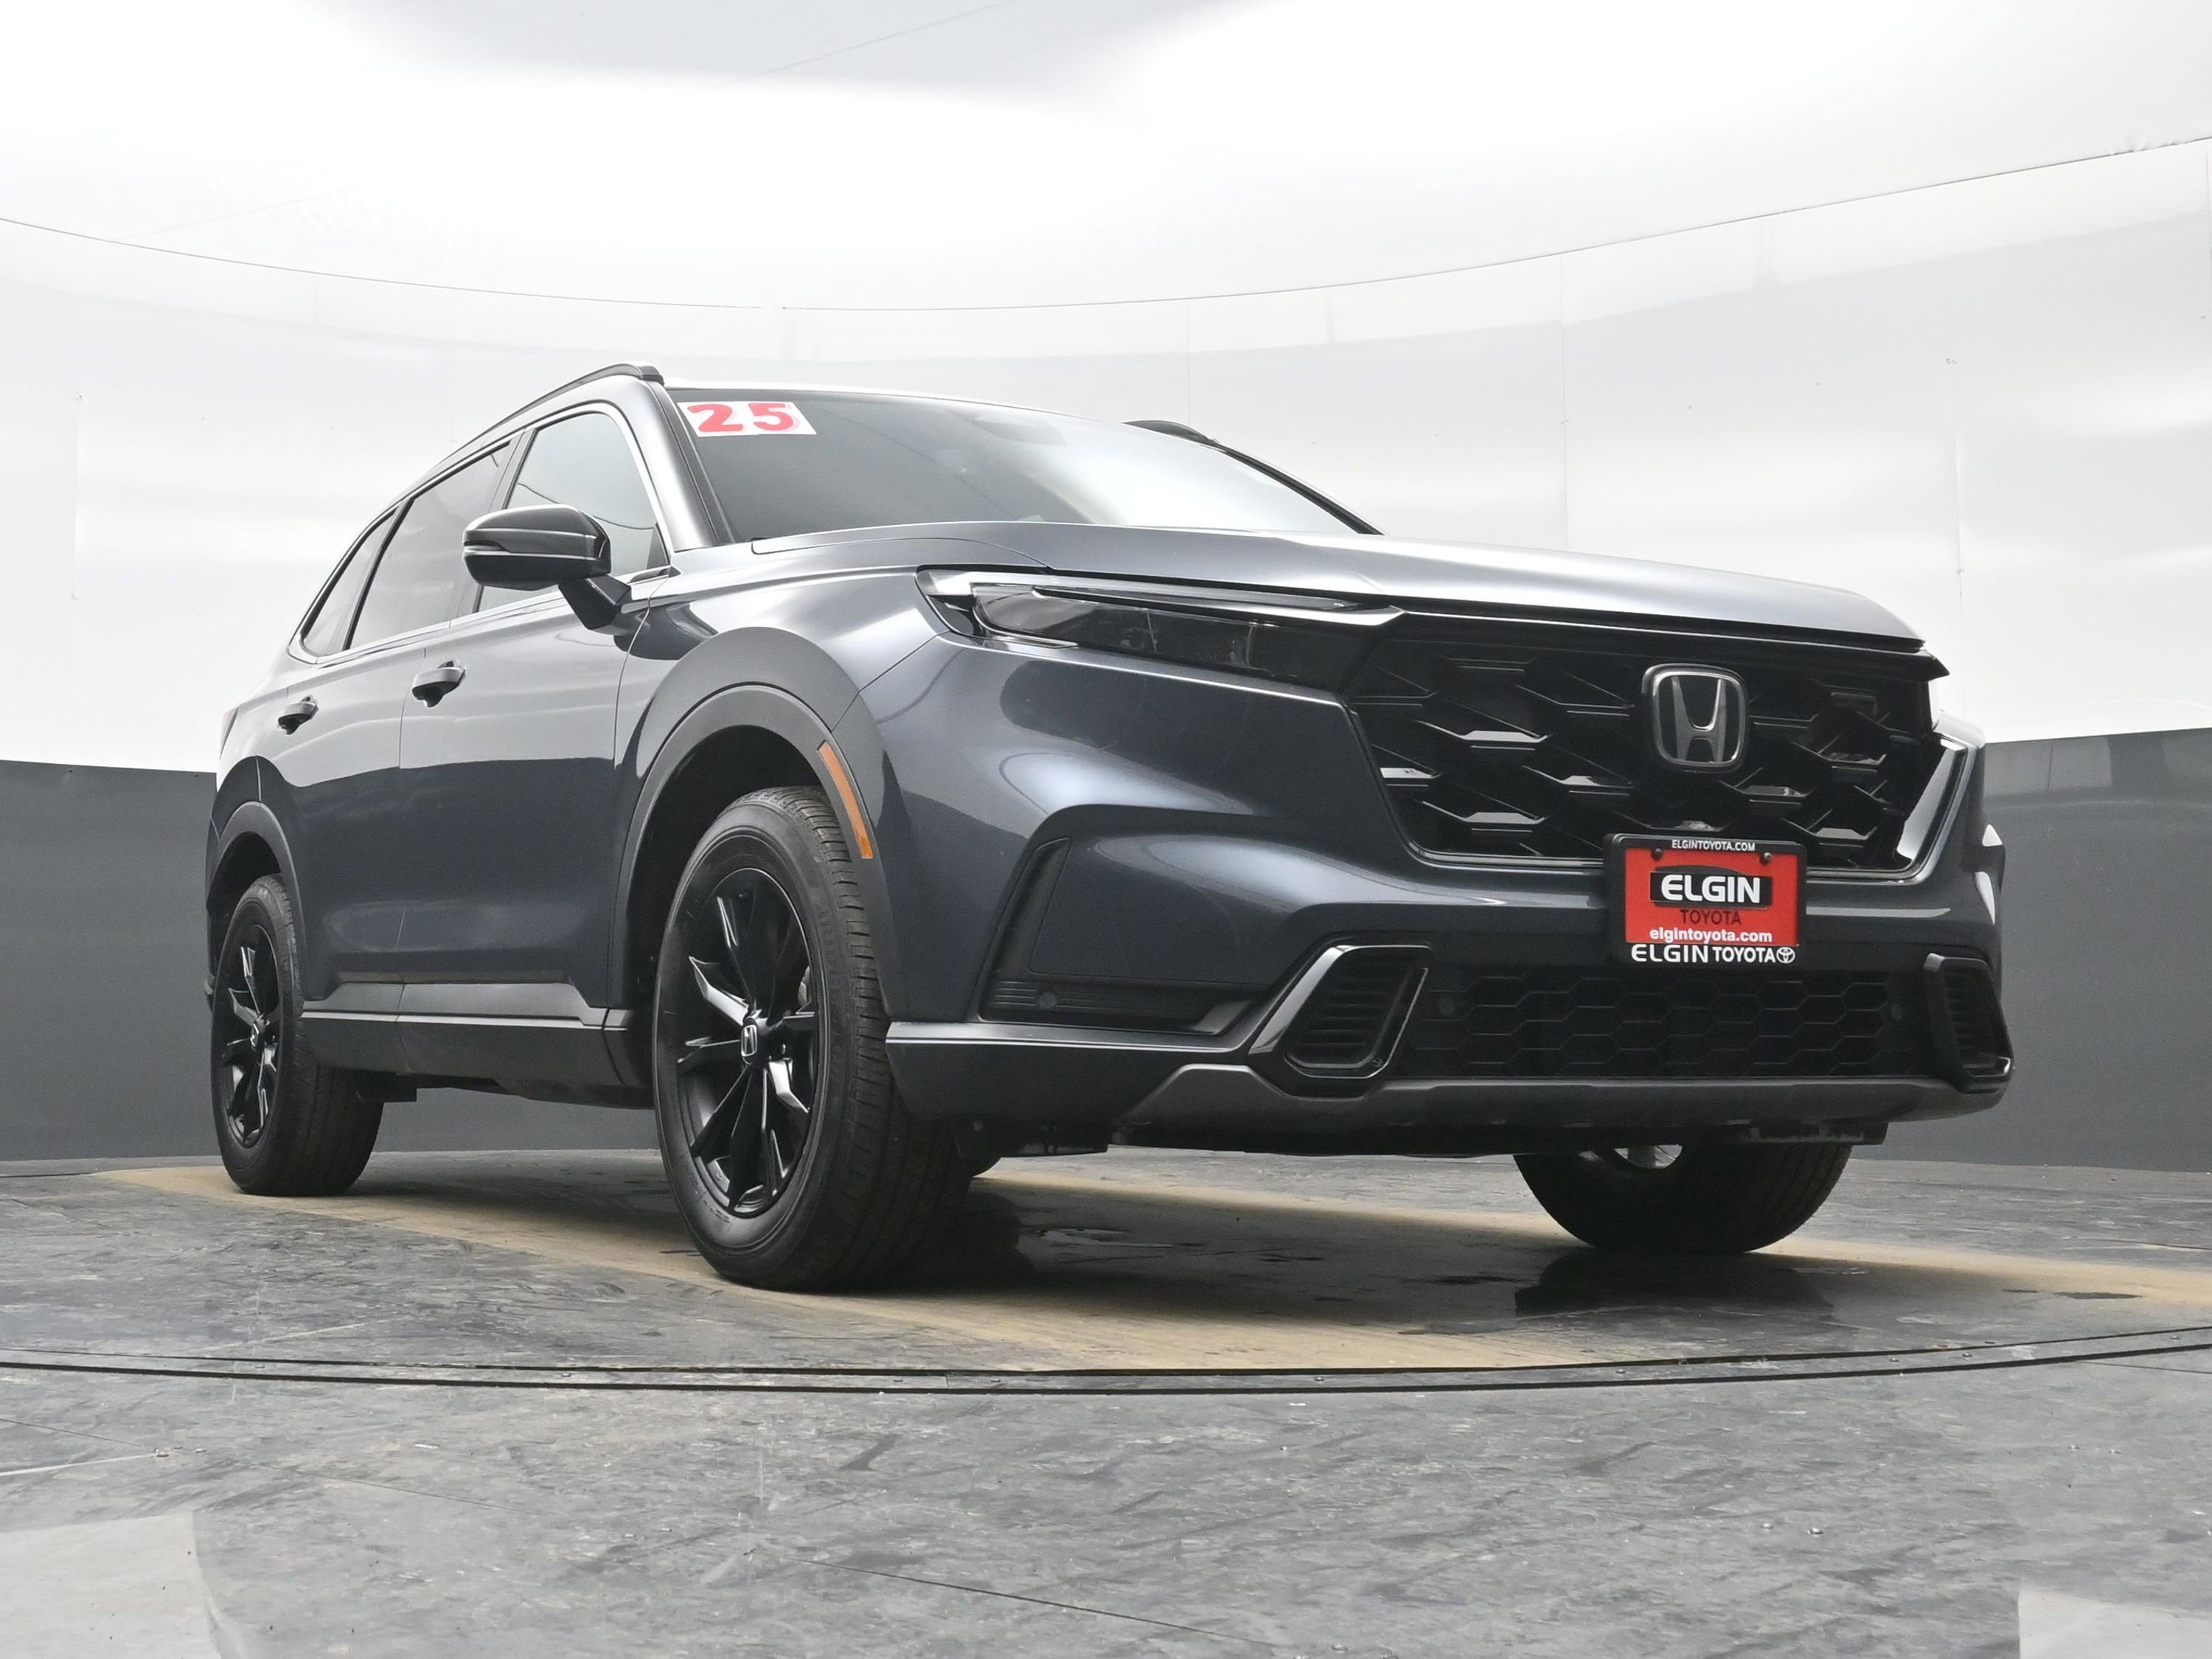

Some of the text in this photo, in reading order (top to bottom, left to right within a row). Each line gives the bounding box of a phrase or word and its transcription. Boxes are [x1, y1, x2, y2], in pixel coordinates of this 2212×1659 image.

[687, 403, 795, 432] 25
[1672, 839, 1756, 852] ELGINTOYOTA.COM
[1661, 874, 1761, 903] ELGIN
[1680, 909, 1742, 925] TOYOTA
[1649, 927, 1773, 943] elgintoyota.com
[1631, 944, 1776, 963] ELGIN TOYOTA
